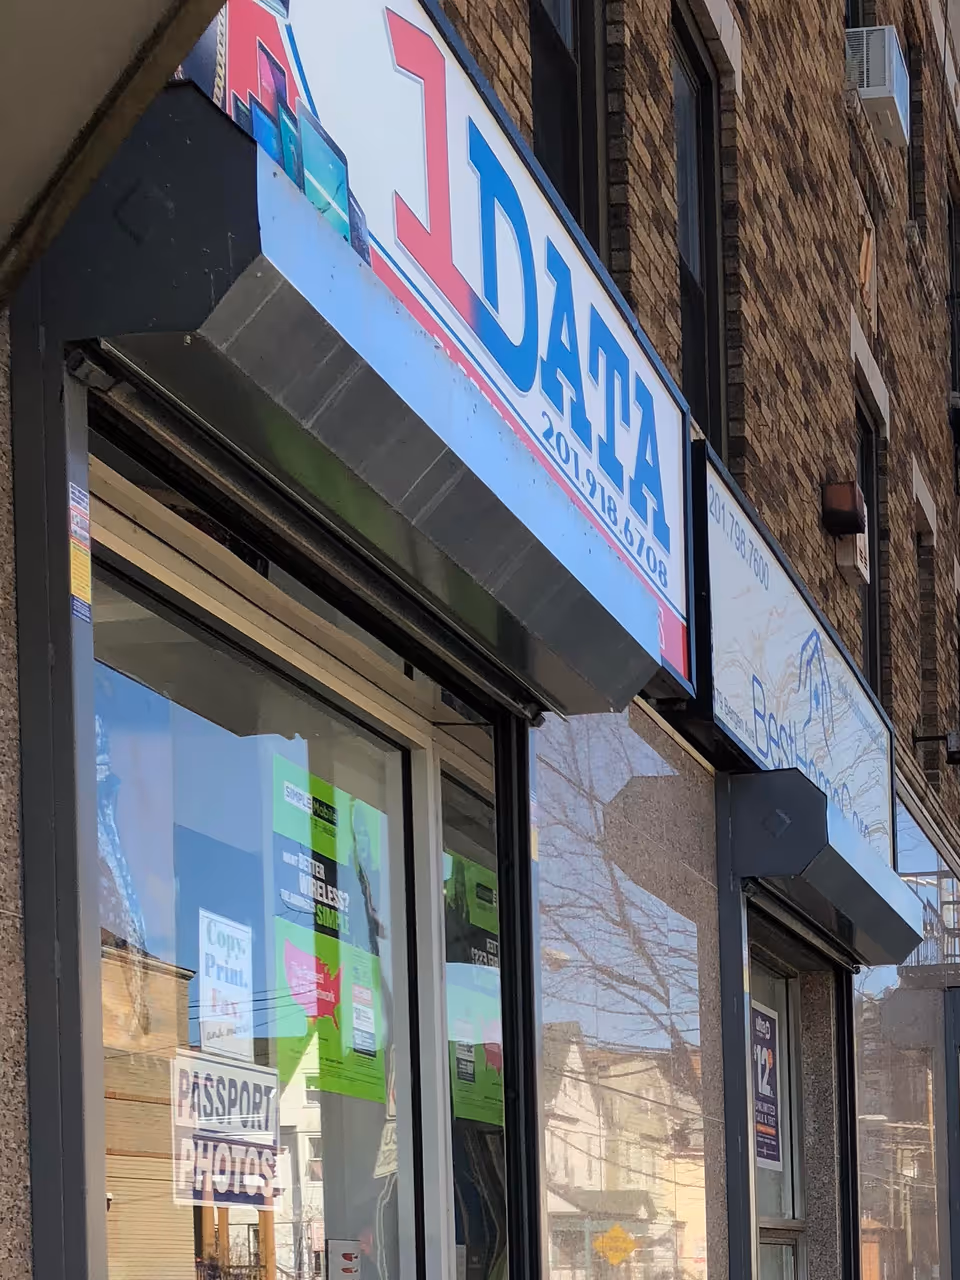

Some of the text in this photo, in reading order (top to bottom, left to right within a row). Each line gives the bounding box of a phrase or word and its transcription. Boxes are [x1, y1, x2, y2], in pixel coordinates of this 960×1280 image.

[541, 411, 668, 588] 201.918.6708
[709, 484, 769, 591] 201.798.7600
[752, 673, 797, 769] Best
[285, 785, 337, 826] SIMPLE Mobile
[299, 853, 325, 880] BETTER
[300, 872, 350, 914] WIRELESS?
[316, 903, 350, 935] SIMPLE
[178, 1067, 277, 1132] PASSPORT
[178, 1137, 276, 1197] PHOTOS
